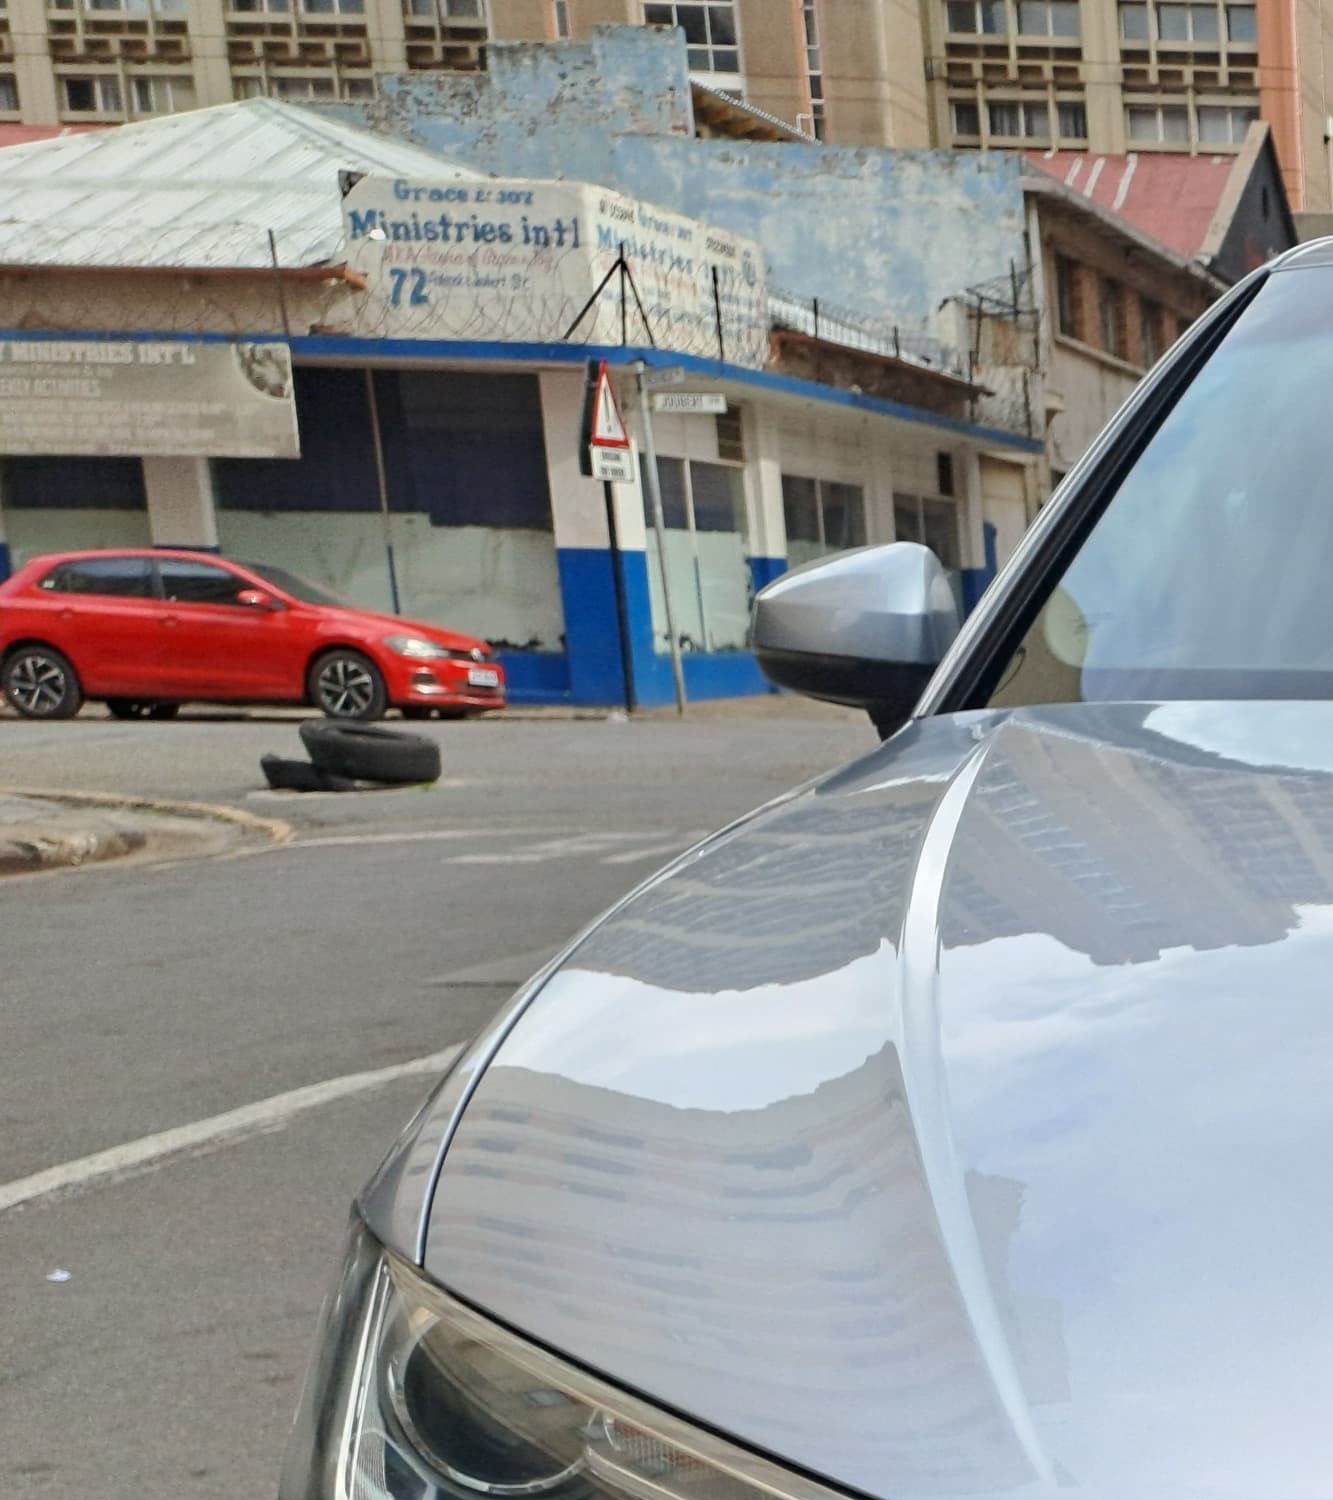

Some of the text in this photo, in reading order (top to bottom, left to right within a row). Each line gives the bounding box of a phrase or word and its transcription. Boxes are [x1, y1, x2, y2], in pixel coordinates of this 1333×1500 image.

[393, 178, 469, 203] Grace
[349, 208, 514, 244] Ministries
[389, 267, 431, 306] 72
[11, 342, 134, 364] MINISTRIES
